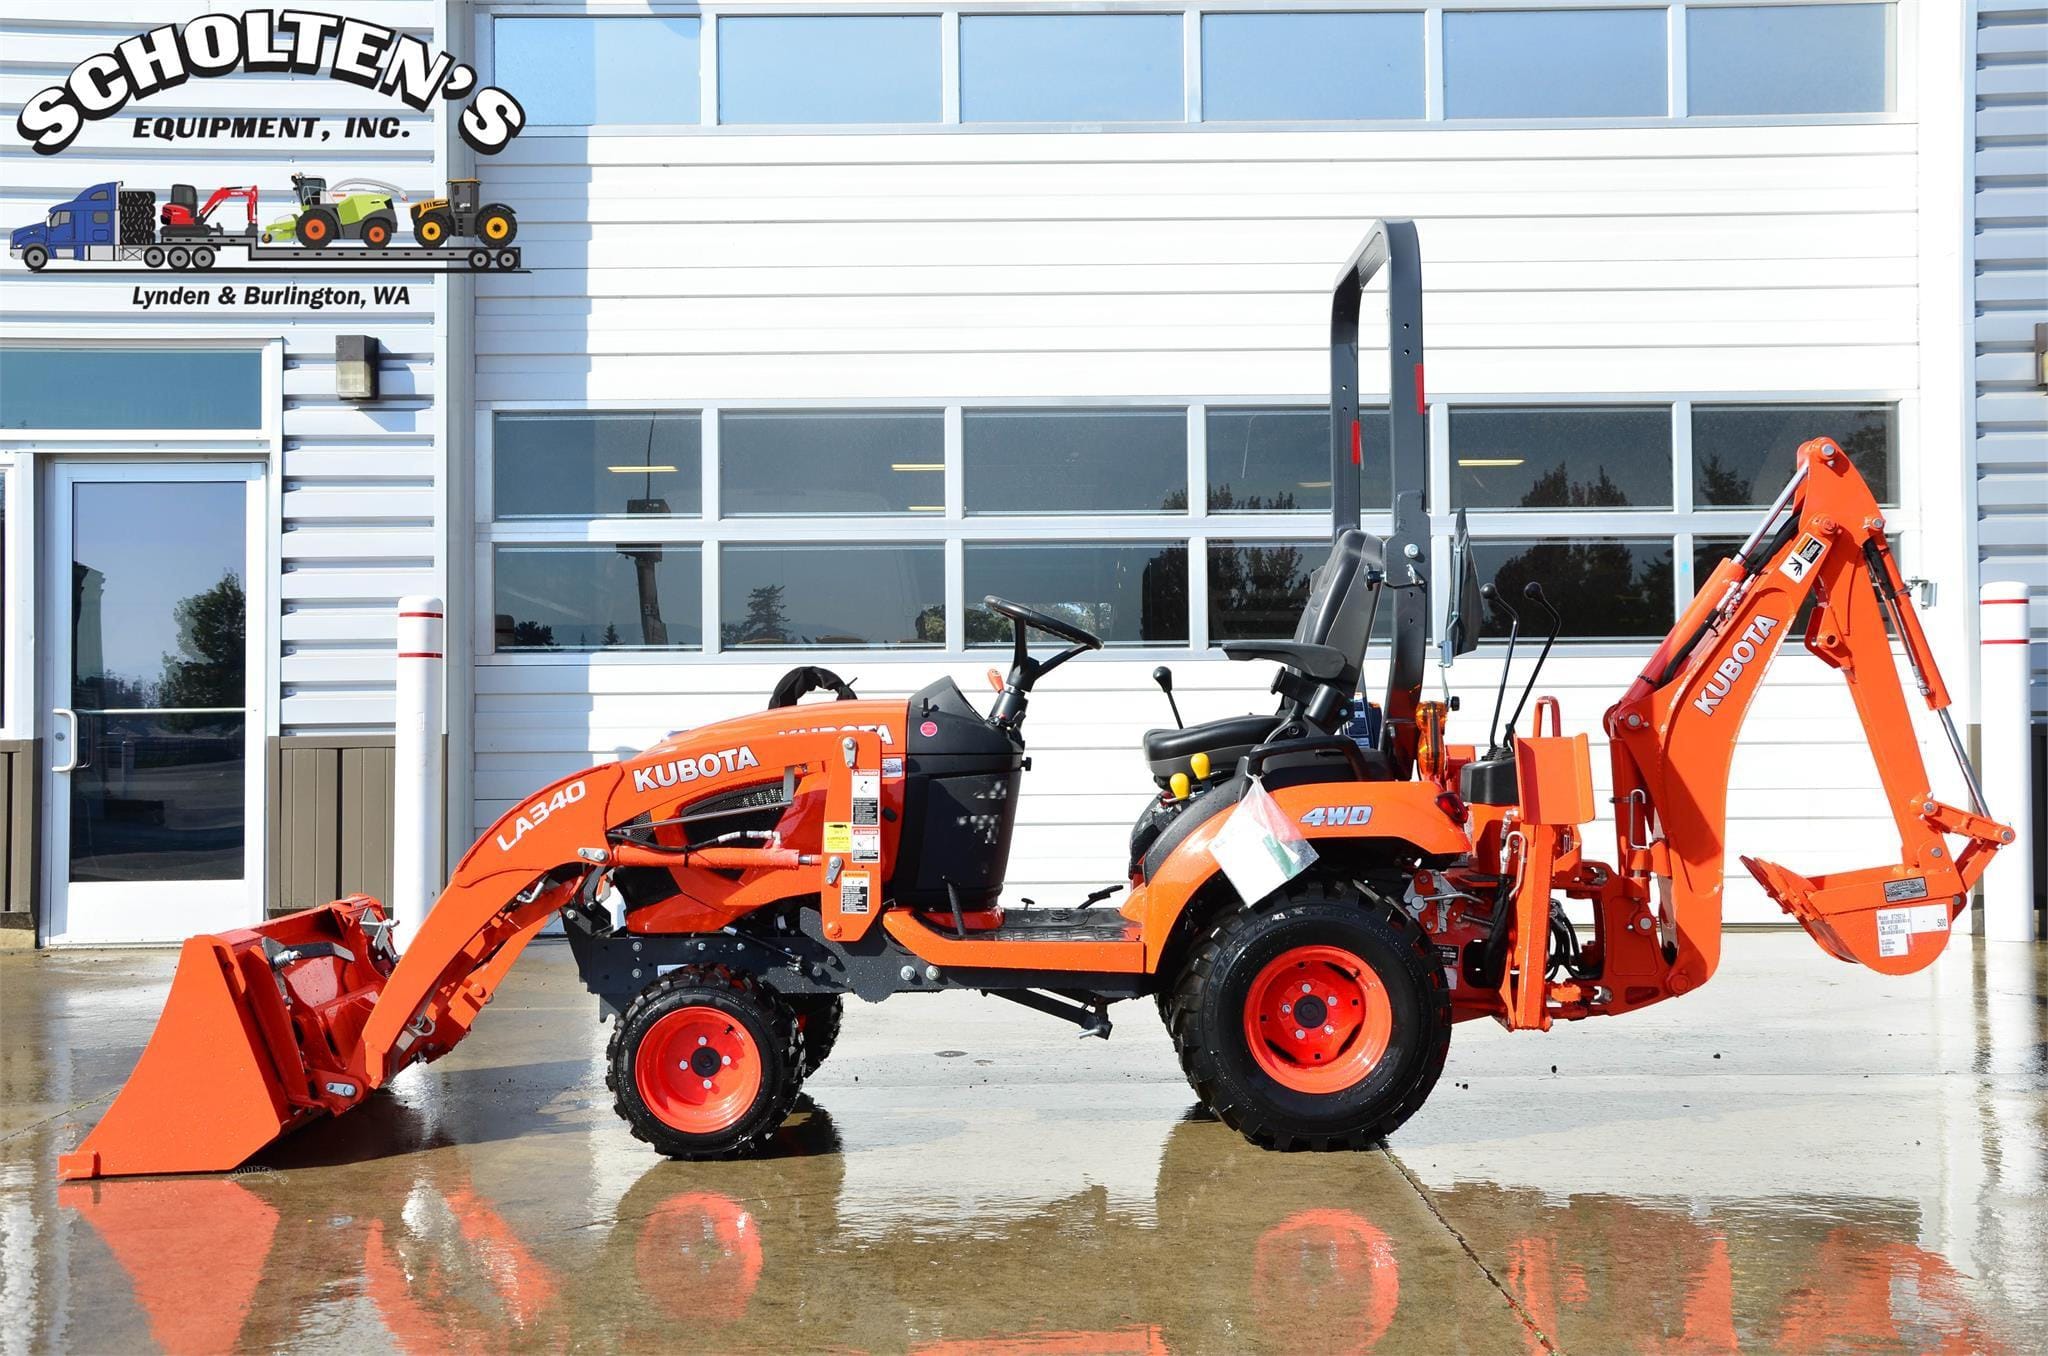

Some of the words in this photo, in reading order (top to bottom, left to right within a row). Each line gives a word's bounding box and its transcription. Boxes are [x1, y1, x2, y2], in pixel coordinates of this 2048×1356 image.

[1693, 613, 1779, 717] KUBOTA
[632, 744, 760, 793] KUBOTA
[496, 780, 587, 852] LA340
[1299, 805, 1373, 827] 4WD
